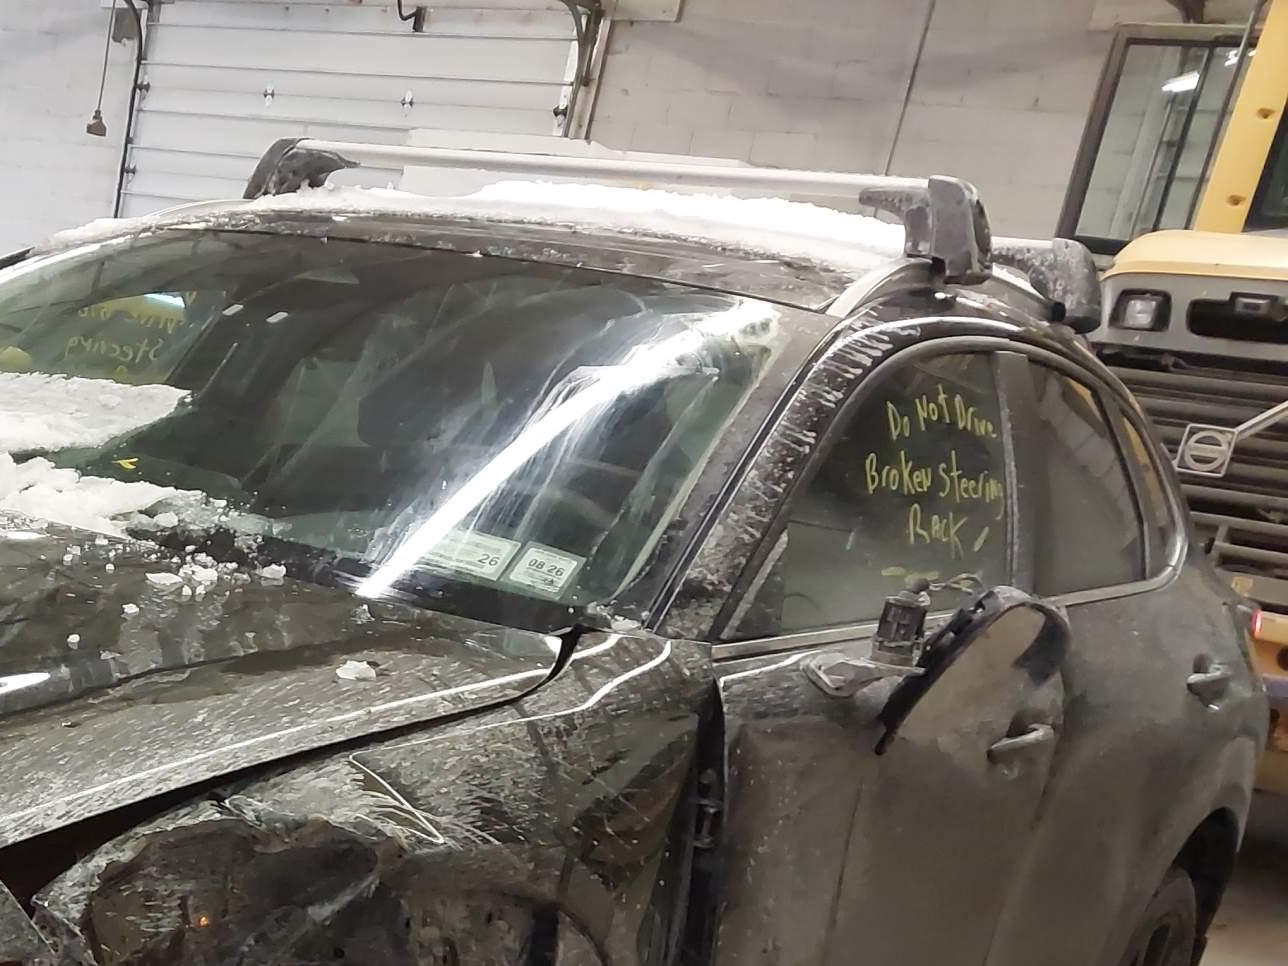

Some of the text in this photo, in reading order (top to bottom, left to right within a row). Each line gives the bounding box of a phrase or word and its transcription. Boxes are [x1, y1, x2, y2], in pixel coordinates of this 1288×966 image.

[886, 400, 910, 440] Do
[477, 553, 501, 567] 26
[546, 564, 566, 577] 26
